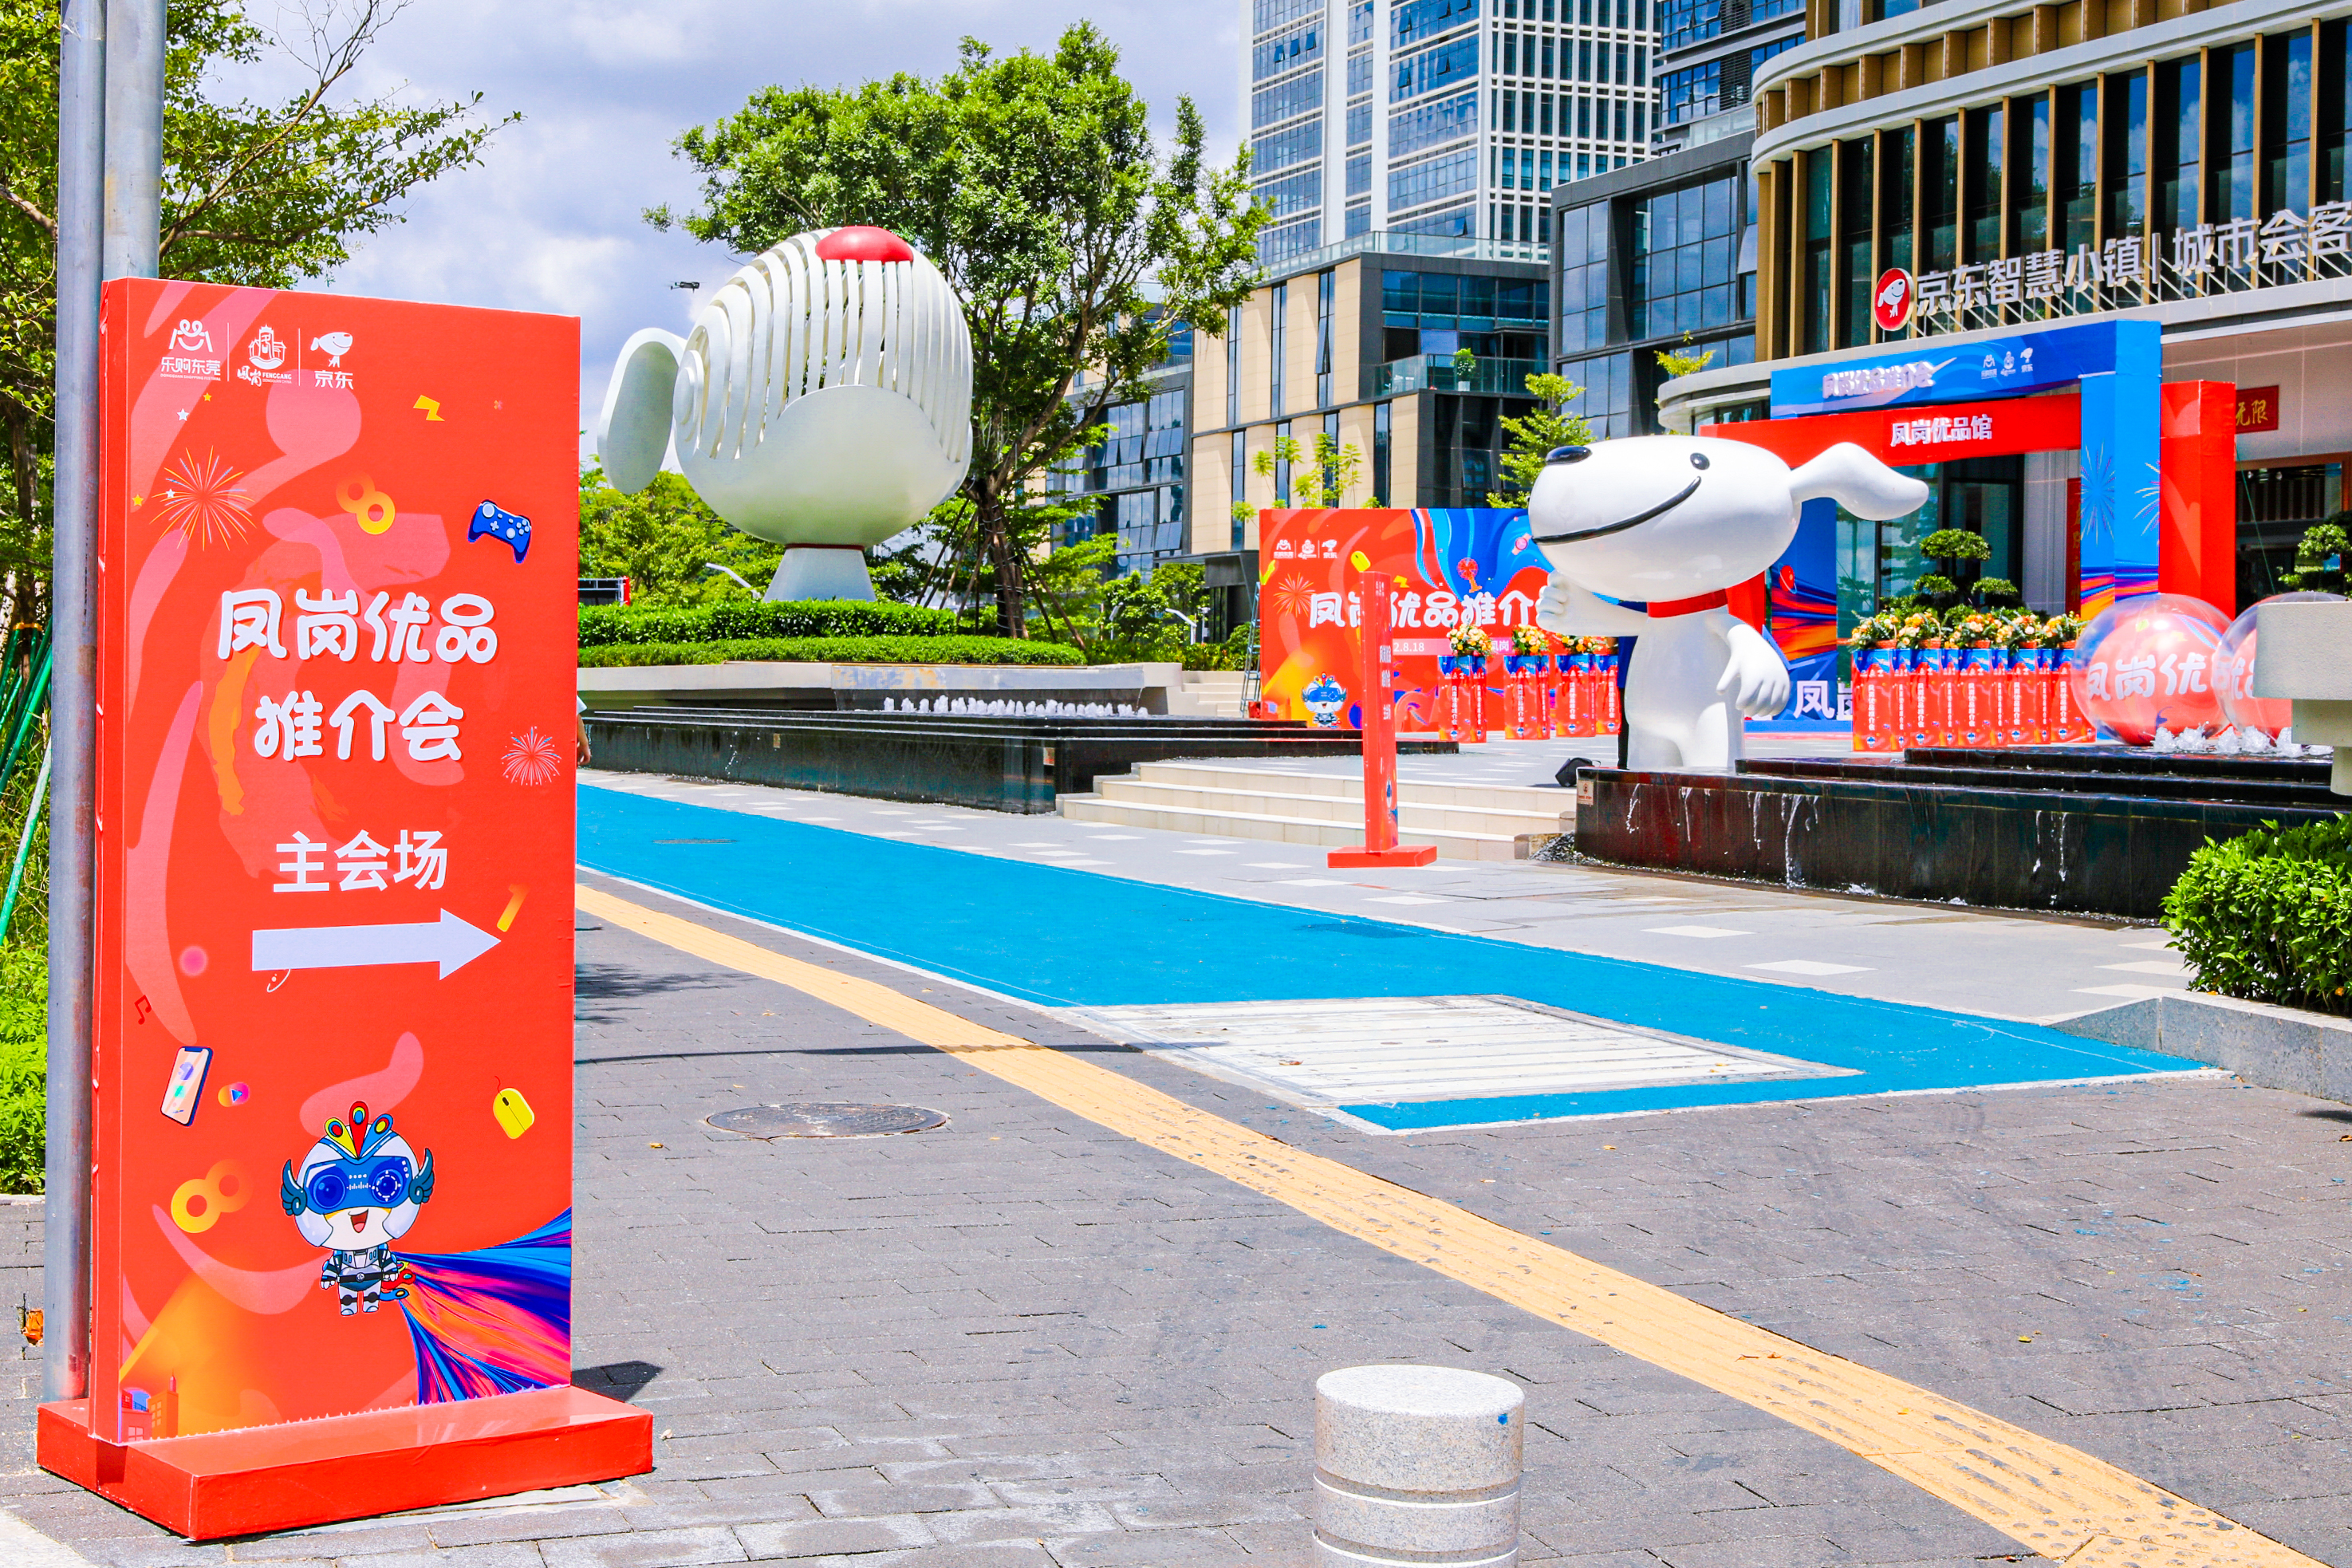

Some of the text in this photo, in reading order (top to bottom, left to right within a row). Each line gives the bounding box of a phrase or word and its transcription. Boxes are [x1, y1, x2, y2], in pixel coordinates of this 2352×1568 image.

[1917, 236, 2144, 316] 京东智慧小镇
[161, 357, 221, 376] 乐购东莞
[314, 370, 353, 389] 京东
[1890, 414, 1992, 447] 凤岗优品馆
[218, 589, 498, 664] 凤岗优品
[1393, 642, 1424, 652] 2.8.18
[254, 690, 464, 762] 推介会
[274, 829, 448, 892] 主会场
